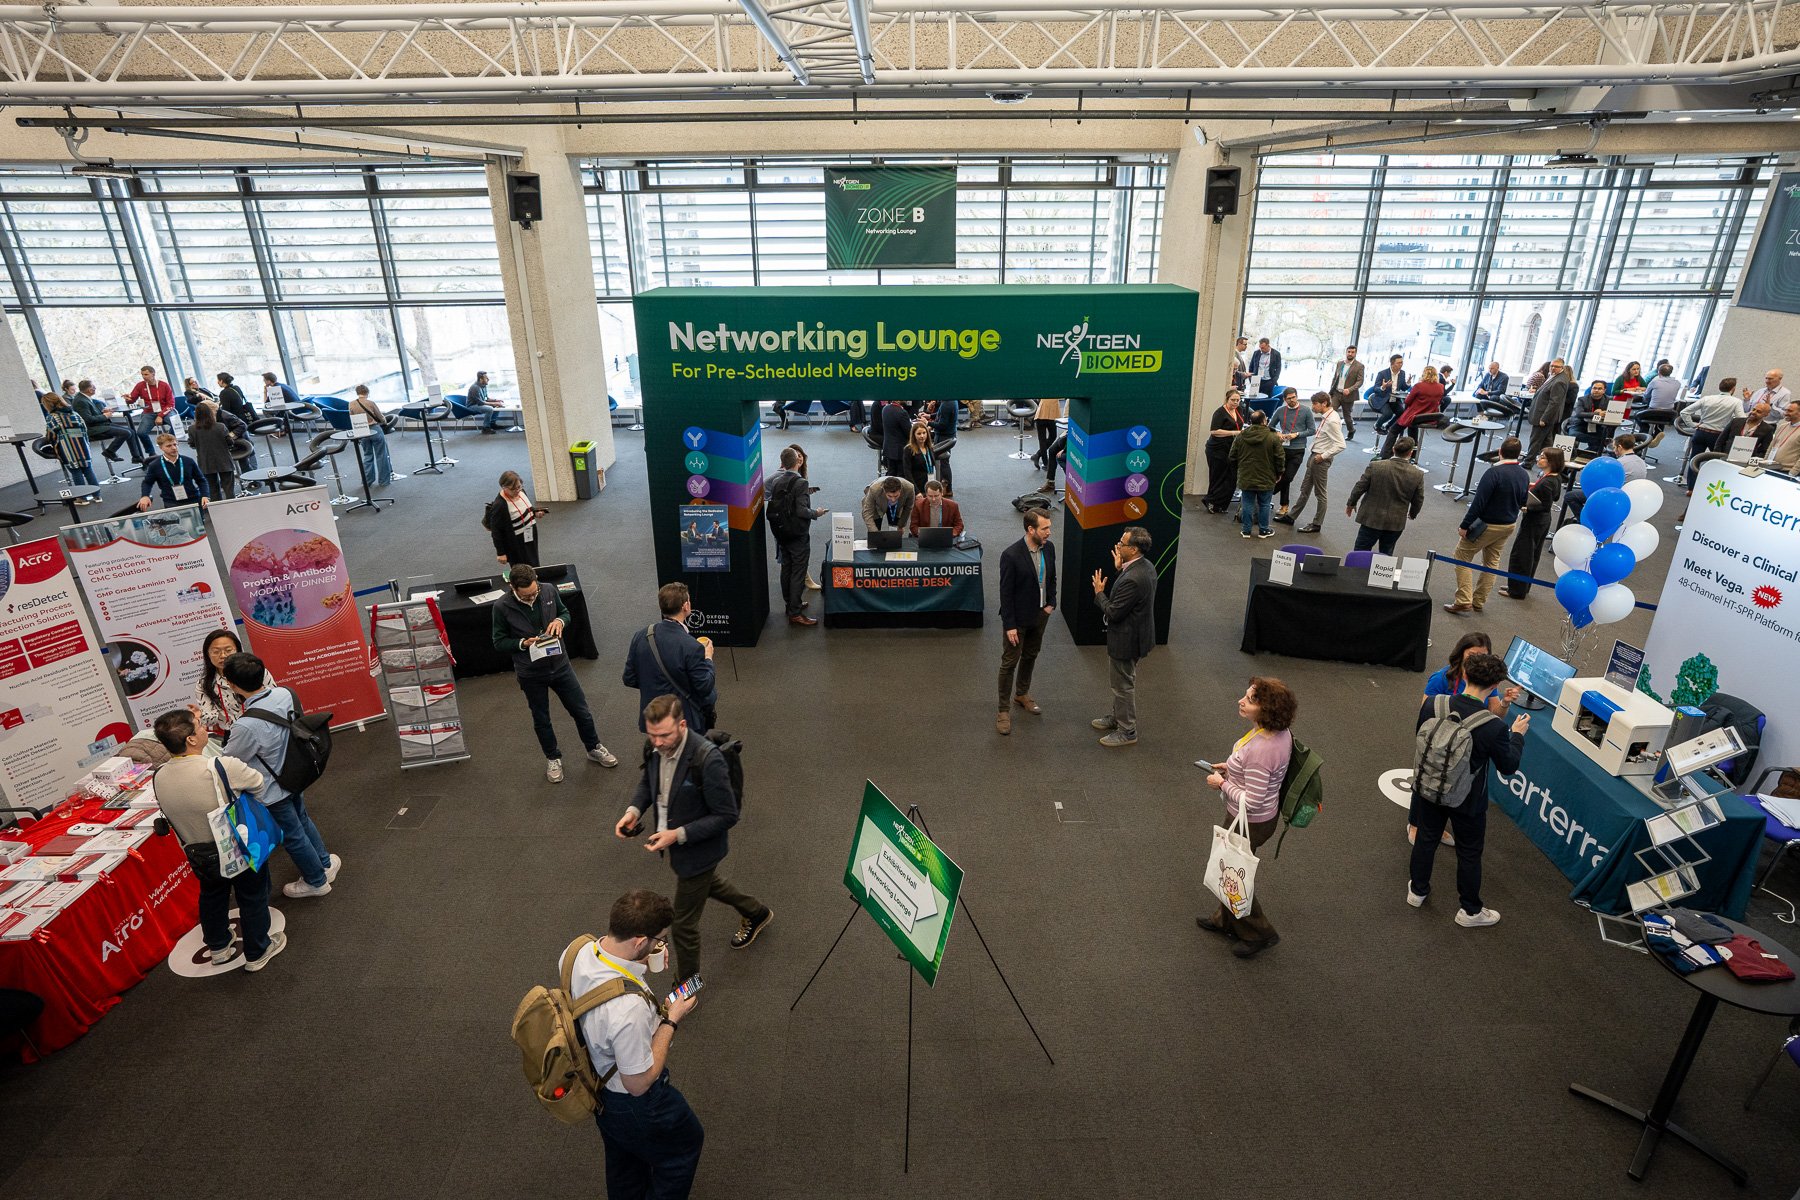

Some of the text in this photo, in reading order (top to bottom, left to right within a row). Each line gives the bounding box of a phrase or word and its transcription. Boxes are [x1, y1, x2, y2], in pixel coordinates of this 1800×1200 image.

[857, 207, 925, 224] ZONE B
[668, 321, 1001, 359] Networking Lounge
[1037, 333, 1140, 350] NEXTGEN
[1086, 354, 1156, 370] BIOMED
[671, 362, 917, 381] For Pre-Scheduled Meetings
[1556, 444, 1572, 452] SGS
[1730, 496, 1800, 532] carterr
[88, 553, 180, 576] Cell and Gene Therapy
[1692, 530, 1798, 583] Discover a Clinical
[90, 566, 152, 584] CMC Solutions
[855, 566, 980, 578] NETWORKING LOUNGE
[1373, 570, 1393, 578] Novor
[1375, 564, 1394, 572] Rapid
[1684, 558, 1745, 595] Meet Vega.
[242, 575, 280, 589] Protein
[292, 565, 337, 579] Antibody
[856, 578, 952, 588] CONCIERGE DESK
[96, 590, 114, 599] GMP
[115, 586, 136, 595] Grade
[137, 581, 166, 590] Laminin
[249, 574, 337, 598] MODALITY DINNER
[17, 590, 68, 612] resDetect
[1757, 591, 1777, 603] NEW
[40, 602, 72, 615] Process
[174, 606, 222, 620] Target-specific
[1678, 576, 1723, 606] 48-Channel
[1723, 598, 1754, 620] HT-SPR
[1754, 612, 1794, 638] Platform
[0, 610, 75, 636] etection Solutions
[172, 611, 224, 626] Magnetic Beads
[304, 647, 326, 656] NextGen
[326, 643, 346, 651] Biomed
[69, 658, 94, 670] Detection
[140, 700, 174, 712] Mycoplasma
[142, 706, 169, 716] Detection
[30, 743, 56, 756] Detection
[14, 779, 30, 788] Other
[883, 850, 917, 890] Exhibition Hall
[148, 880, 168, 900] Where
[154, 878, 181, 908] Advance
[868, 865, 894, 898] Networking
[893, 894, 912, 916] Lounge
